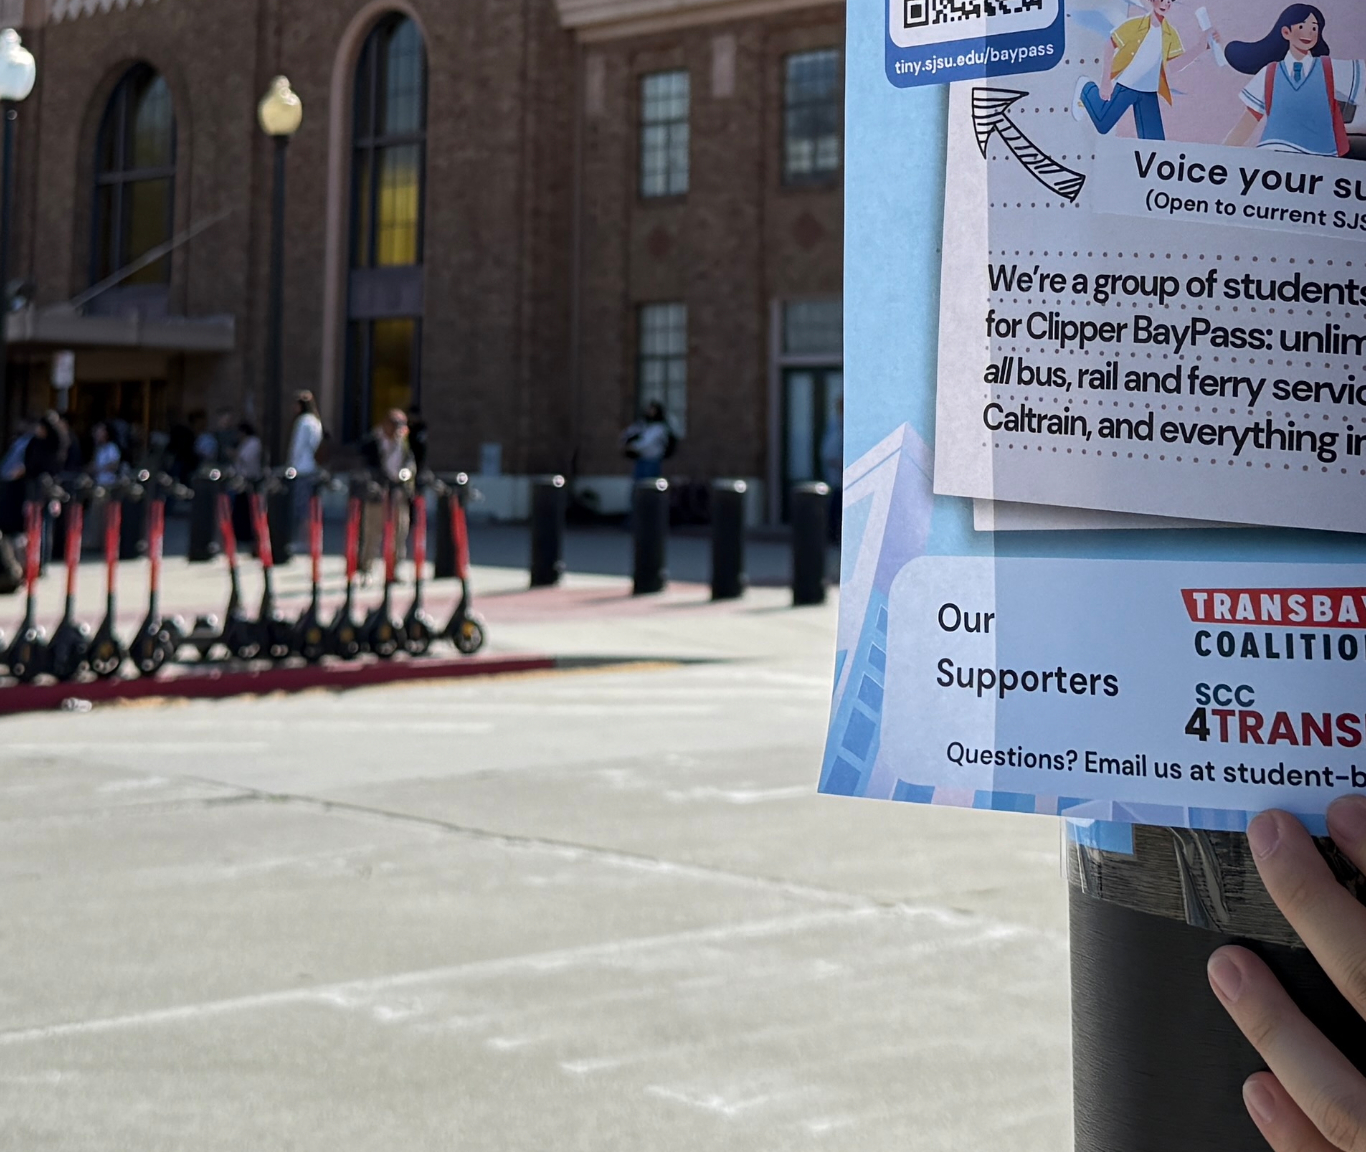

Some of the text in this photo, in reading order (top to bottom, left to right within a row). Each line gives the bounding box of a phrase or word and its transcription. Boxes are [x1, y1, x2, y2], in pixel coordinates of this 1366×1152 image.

[894, 43, 1054, 76] tiny.sjsu.edu/baypass
[1134, 150, 1228, 186] Voice
[1239, 167, 1323, 196] your
[1145, 188, 1209, 215] (Open
[1215, 198, 1237, 216] to
[1243, 204, 1327, 226] current
[988, 264, 1067, 293] We're
[1072, 273, 1088, 294] a
[1093, 273, 1180, 305] group
[1186, 268, 1218, 298] of
[985, 309, 1023, 338] for
[1026, 311, 1128, 350] Clipper
[1133, 314, 1274, 355] BayPass:
[983, 356, 1014, 385] all
[1017, 356, 1072, 392] bus,
[1078, 361, 1119, 390] rail
[1124, 364, 1182, 395] and
[1187, 365, 1267, 408] ferry
[983, 402, 1093, 442] Caltrain,
[1098, 411, 1154, 442] and
[1160, 418, 1339, 463] everything
[938, 602, 996, 634] Our
[936, 657, 1120, 699] Supporters
[1195, 682, 1255, 708] SCC
[946, 741, 1078, 771] Questions?
[1084, 750, 1147, 777] Email
[1154, 761, 1183, 780] us
[1189, 760, 1216, 782] at
